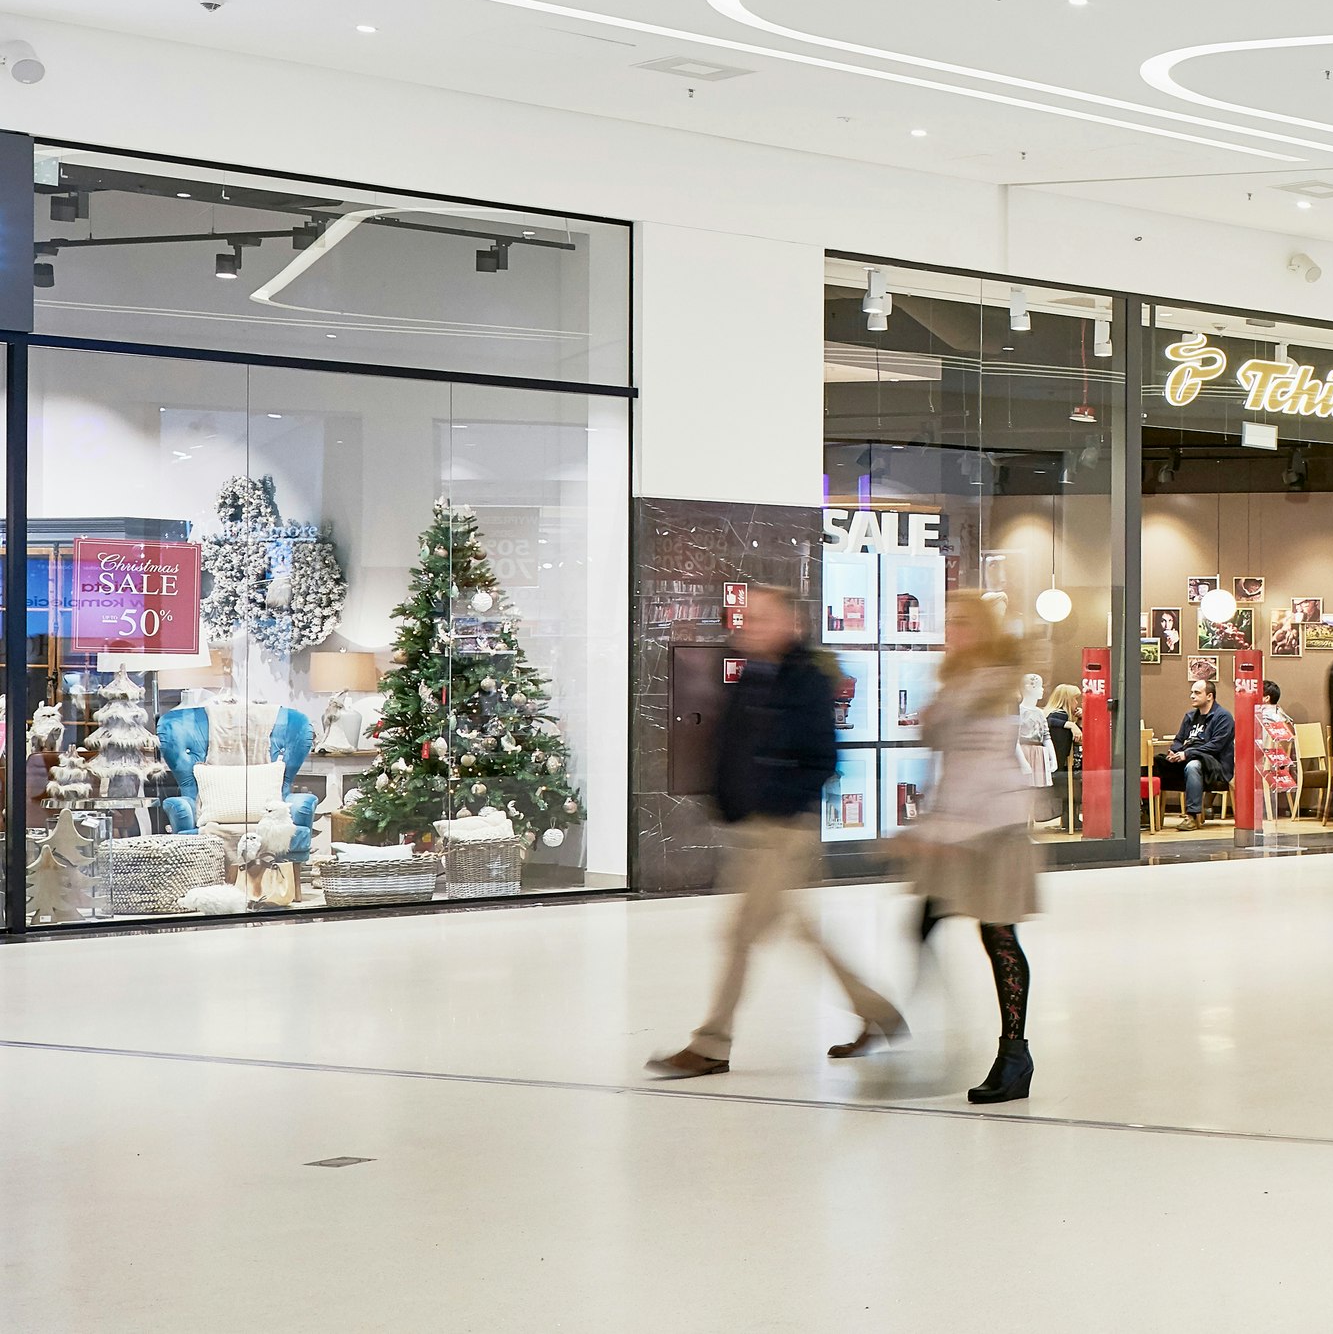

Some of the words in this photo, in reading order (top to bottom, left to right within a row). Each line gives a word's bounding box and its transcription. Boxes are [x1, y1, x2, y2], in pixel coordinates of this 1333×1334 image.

[823, 509, 940, 556] SALE
[97, 552, 180, 574] Christmas
[98, 572, 178, 596] SALE
[1082, 678, 1105, 694] SALE
[1235, 678, 1258, 694] SALE
